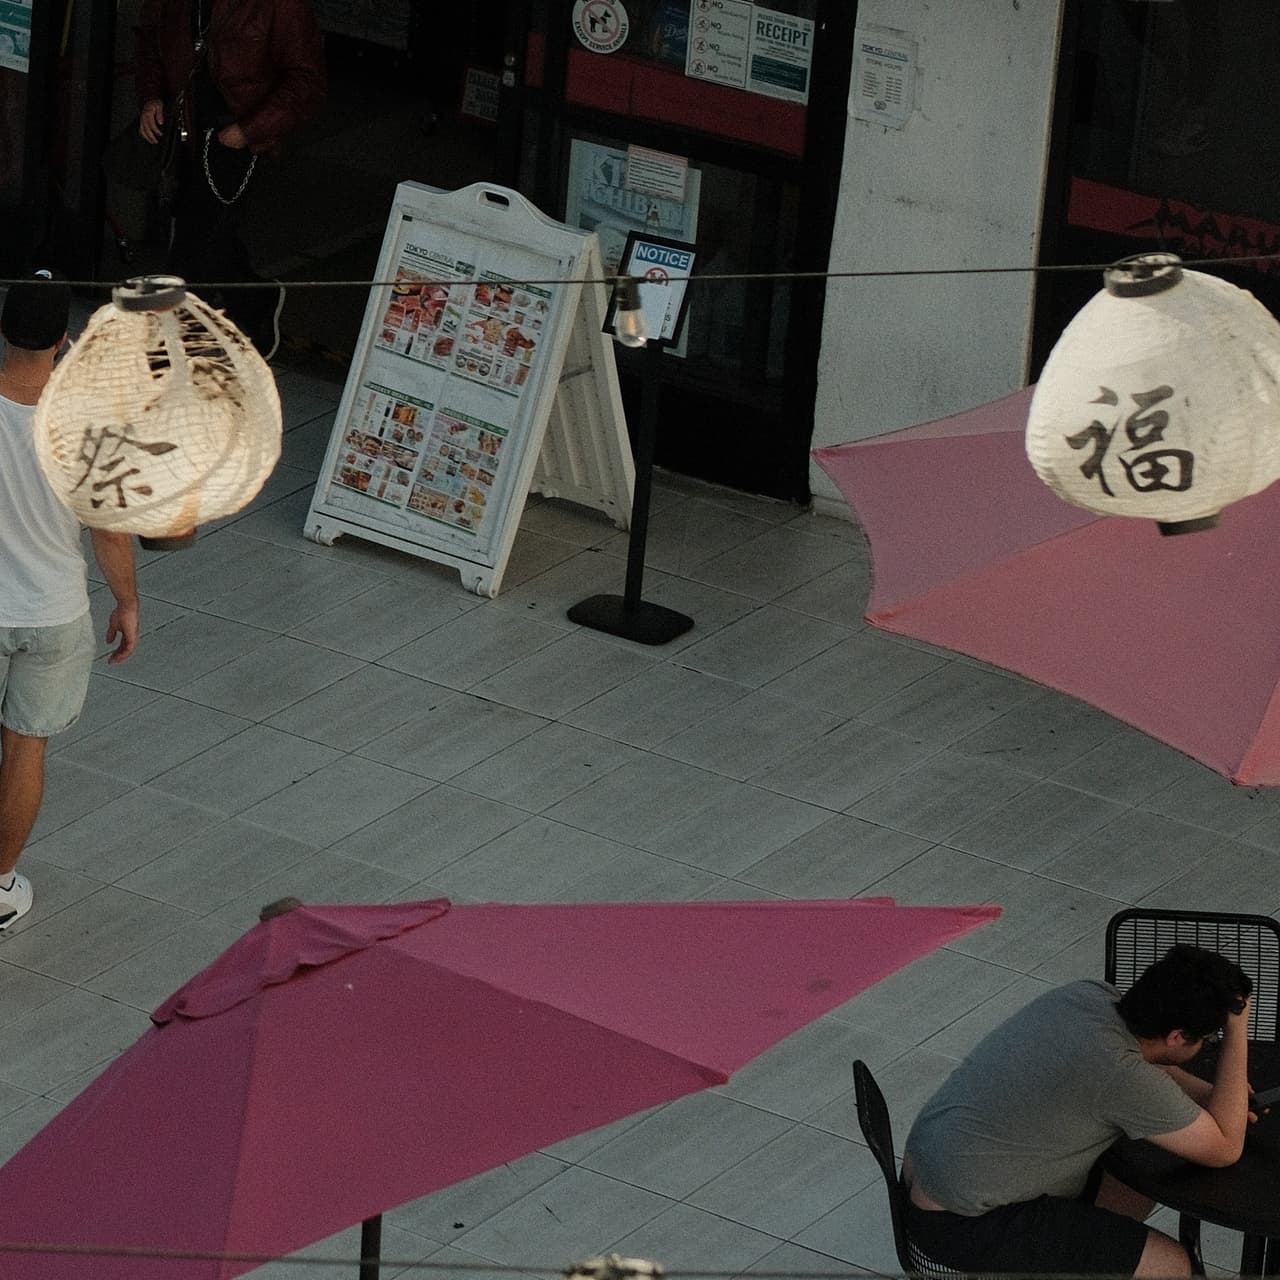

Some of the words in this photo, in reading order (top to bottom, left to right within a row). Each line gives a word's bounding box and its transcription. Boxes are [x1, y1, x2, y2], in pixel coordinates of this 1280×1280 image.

[711, 0, 724, 9] NO
[710, 21, 722, 30] NO
[755, 20, 809, 47] RECEIPT
[709, 42, 720, 51] NO
[707, 64, 719, 73] NO
[405, 243, 428, 256] TOKYO
[636, 244, 691, 269] NOTICE
[1065, 385, 1195, 498] 福
